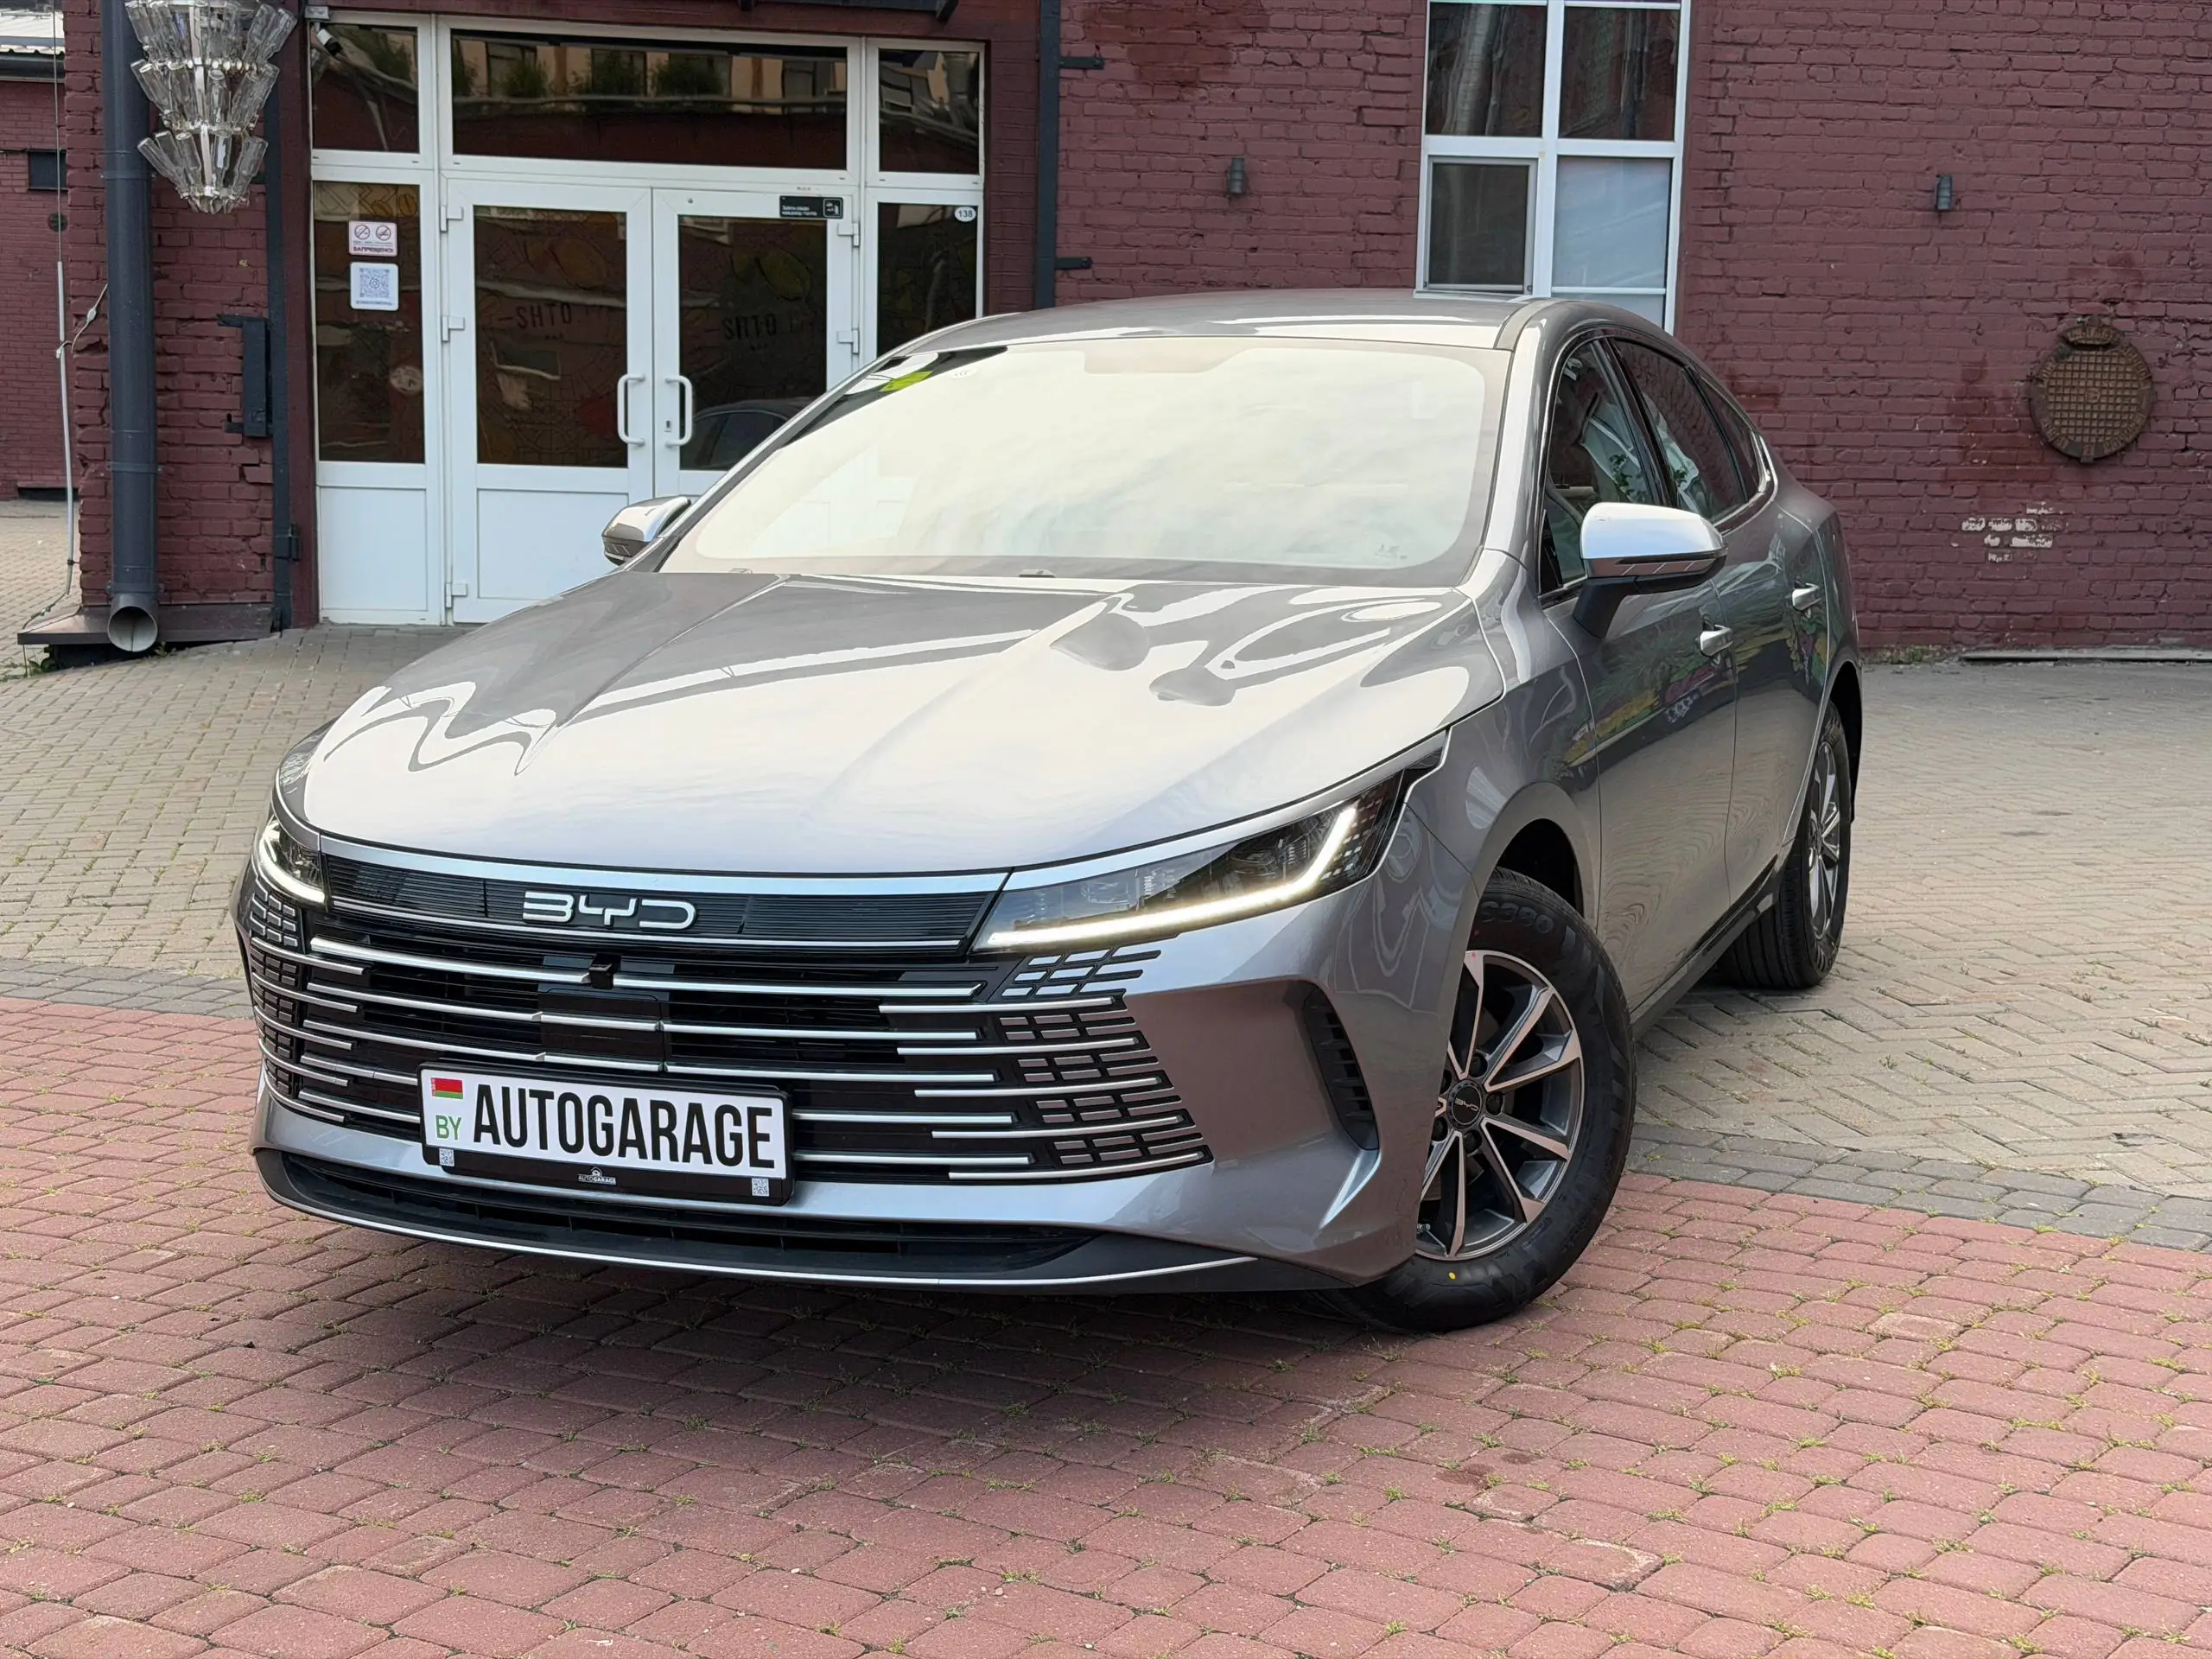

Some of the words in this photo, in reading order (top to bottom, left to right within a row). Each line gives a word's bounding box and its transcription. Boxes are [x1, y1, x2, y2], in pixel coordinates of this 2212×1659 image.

[523, 891, 696, 930] BYD
[1454, 1096, 1479, 1112] BYD
[435, 1115, 462, 1141] BY
[473, 1084, 775, 1170] AUTOGARAGE
